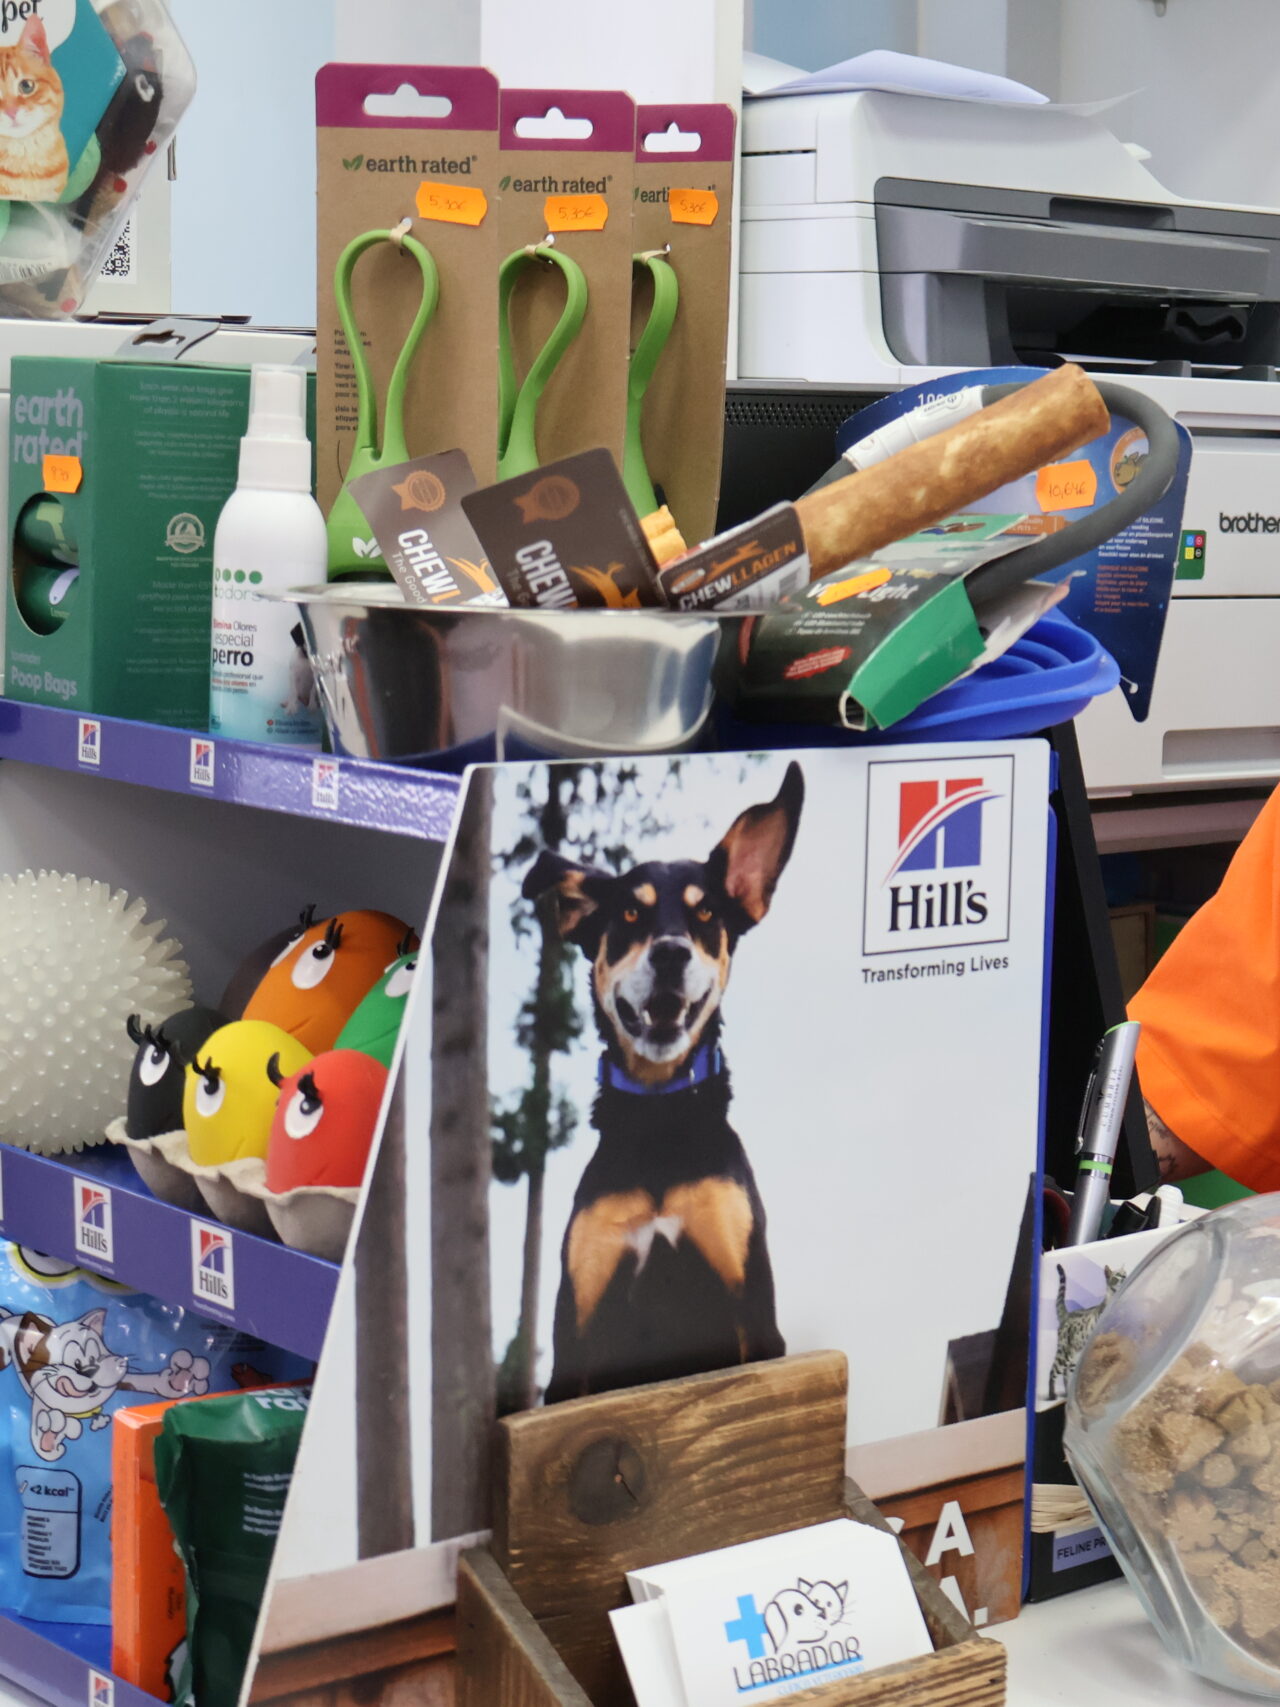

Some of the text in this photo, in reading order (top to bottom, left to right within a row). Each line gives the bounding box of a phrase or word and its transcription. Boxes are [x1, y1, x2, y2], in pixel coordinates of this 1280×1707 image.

[366, 156, 418, 174] earth
[513, 175, 556, 193] earth
[14, 386, 84, 428] earth
[214, 632, 254, 647] especial
[233, 620, 258, 632] Olores
[212, 647, 254, 668] perro
[11, 665, 78, 701] Poop Bags
[888, 879, 988, 932] Hill's
[862, 955, 1009, 984] Transforming Lives
[81, 1226, 108, 1253] Hill's
[199, 1270, 228, 1300] Hill's
[1056, 1540, 1092, 1560] FELINE
[733, 1636, 862, 1690] LABRADOR
